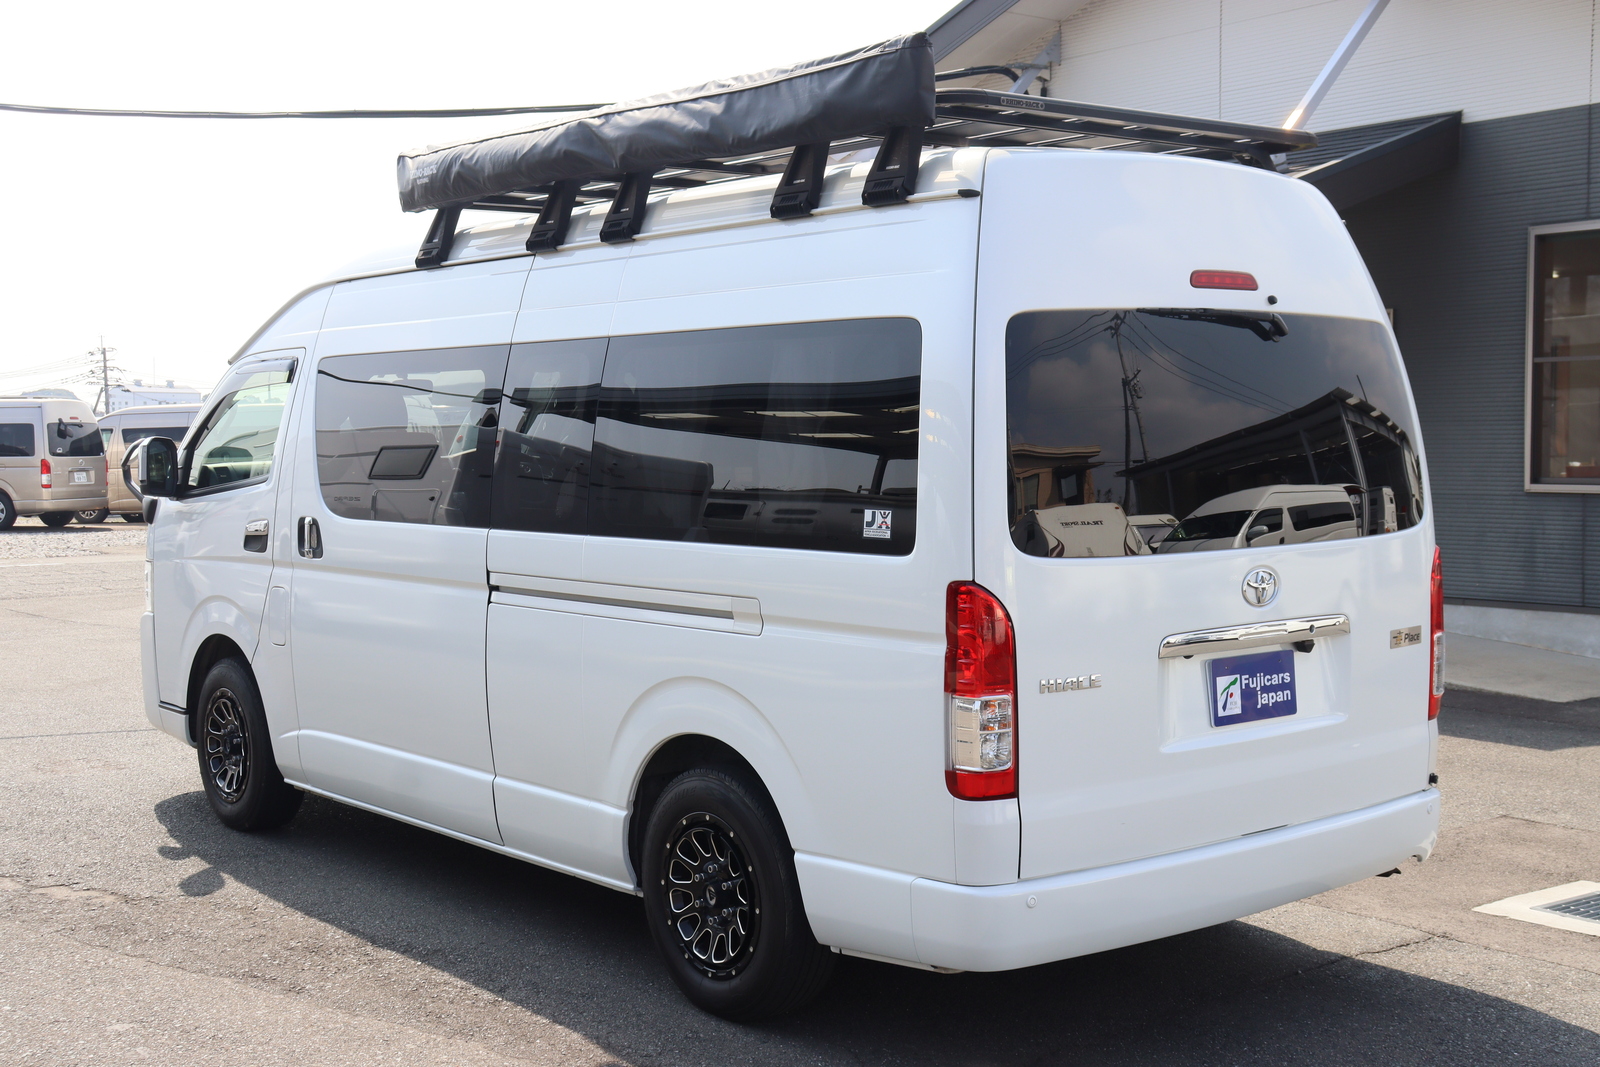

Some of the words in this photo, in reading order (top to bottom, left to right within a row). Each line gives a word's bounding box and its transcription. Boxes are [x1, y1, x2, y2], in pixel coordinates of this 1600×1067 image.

[1005, 98, 1041, 109] RHINO-RACK
[1039, 673, 1102, 694] HIACE
[1241, 672, 1291, 691] Fujicars
[1257, 689, 1291, 709] japan
